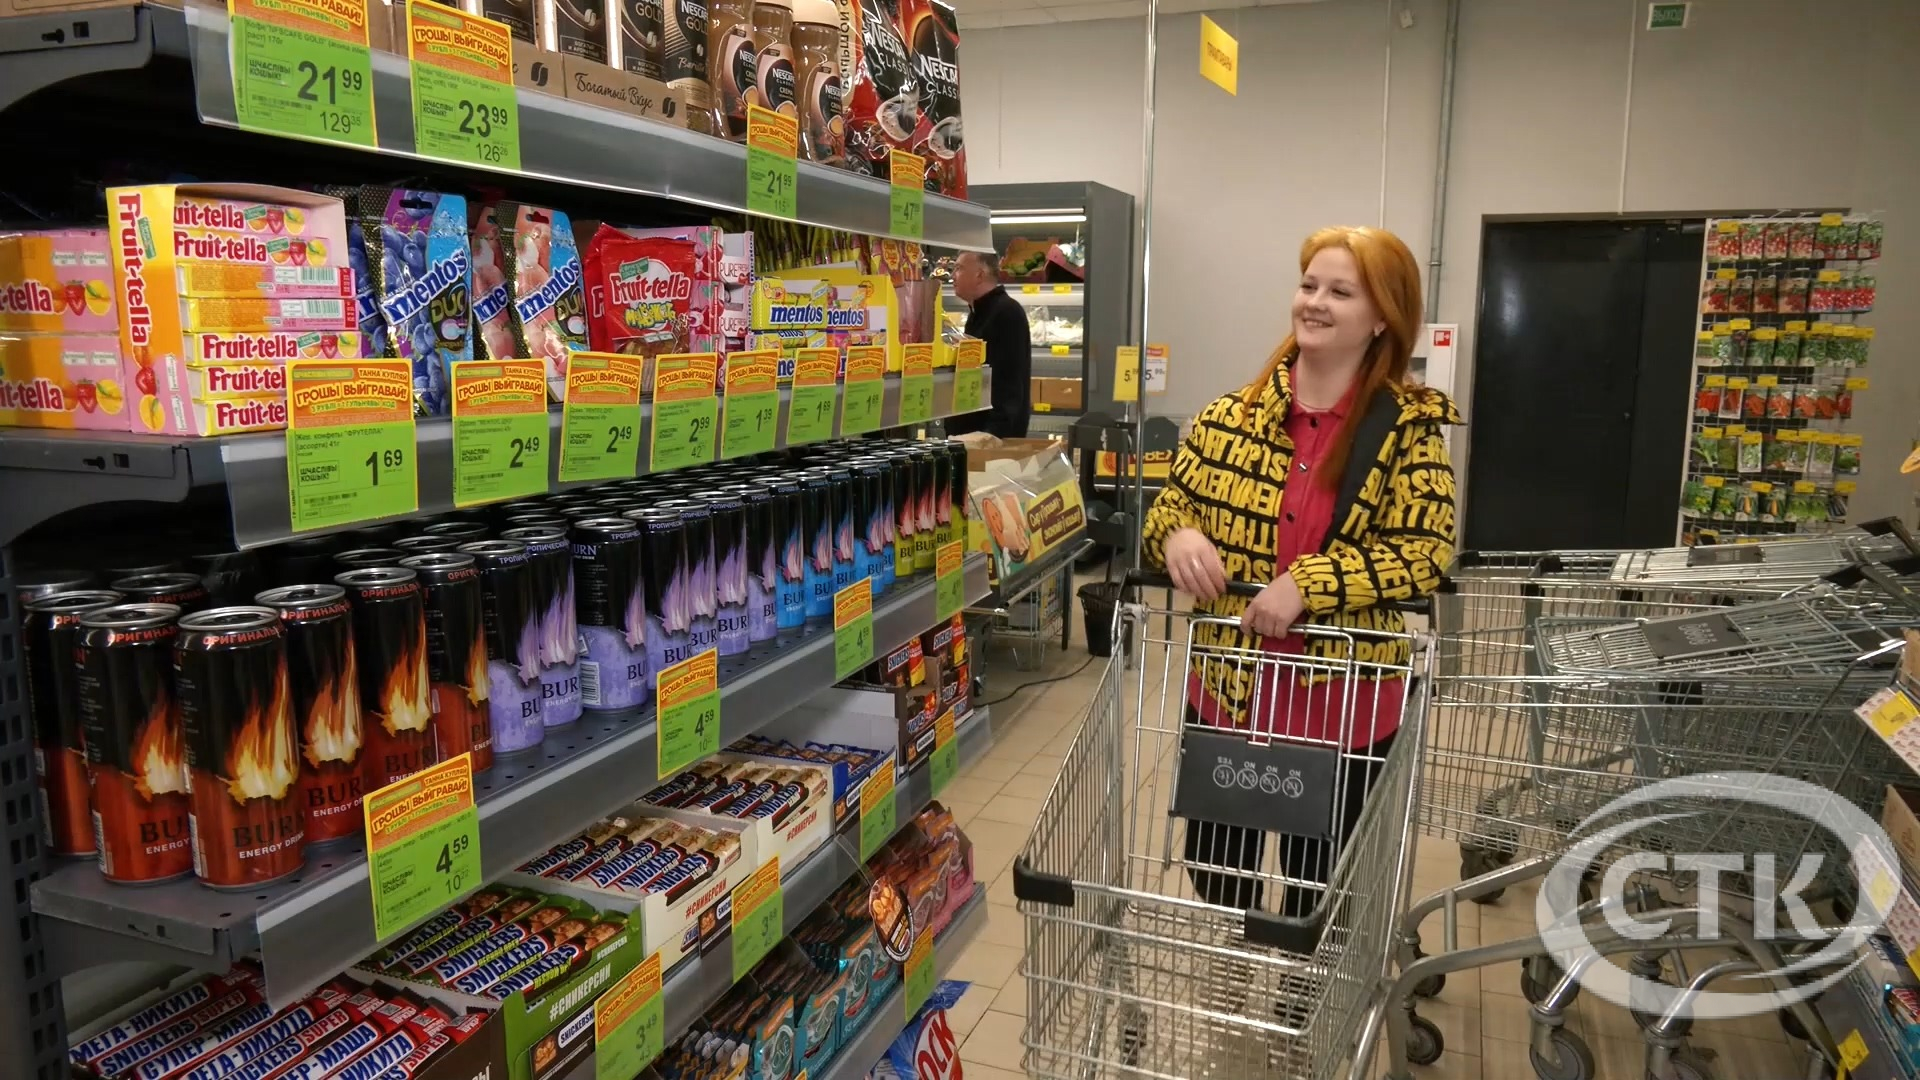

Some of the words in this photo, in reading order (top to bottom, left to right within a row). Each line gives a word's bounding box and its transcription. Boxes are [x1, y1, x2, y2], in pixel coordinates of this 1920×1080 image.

[636, 3, 663, 23] GOLD
[414, 28, 451, 42] ГРОШЫ
[454, 34, 507, 63] ВЫЙГРАВАЙ!
[249, 60, 291, 74] ШЧАСЛІВЫ
[249, 68, 281, 80] КОШЫК!
[921, 54, 958, 85] NESCA
[297, 61, 336, 104] 21
[342, 69, 362, 90] 99
[575, 72, 626, 101] Богатый
[629, 87, 654, 115] Вкус
[926, 82, 958, 99] CLASS
[320, 111, 351, 133] 129
[351, 115, 361, 127] 35
[459, 100, 491, 137] 23
[491, 106, 508, 125] 99
[476, 143, 500, 162] 126
[767, 170, 782, 195] 21
[784, 174, 792, 187] 99
[175, 232, 267, 262] Fruit-tella
[118, 194, 148, 344] Fruit-tella
[720, 262, 738, 278] PURE
[384, 250, 469, 323] mentos
[516, 257, 582, 321] mentos
[610, 274, 689, 304] Fruit-tella
[720, 316, 738, 332] PURE
[770, 304, 823, 323] mentos
[203, 335, 298, 359] Fruit-tella
[208, 368, 286, 392] Fruit-tel
[359, 369, 381, 378] ТАННА
[382, 371, 409, 380] КУПЛЯЙ
[571, 373, 598, 386] ГРОШЫ
[600, 371, 638, 388] ВЫЙГРАВАЙ!
[0, 380, 63, 410] it-tella
[296, 385, 340, 405] ГРОШЫ
[343, 381, 407, 399] ВЫЙГРАВАЙ!
[459, 382, 490, 397] ГРОШЫ
[494, 377, 541, 392] ВЫЙГРАВАЙ!
[816, 401, 822, 423] 1
[866, 395, 872, 414] 1
[689, 418, 700, 442] 2
[700, 416, 710, 429] 99
[756, 409, 763, 433] 1
[763, 408, 773, 421] 39
[606, 426, 619, 453] 2
[620, 426, 632, 440] 49
[509, 438, 524, 468] 2
[525, 436, 540, 452] 49
[300, 472, 329, 483] КОШЫК!
[301, 464, 337, 475] ШЧАСЛІВЫ
[365, 451, 378, 486] 1
[384, 449, 403, 467] 69
[763, 602, 777, 617] BU
[107, 626, 177, 643] ОРИГИНАЛ
[718, 615, 748, 632] BUR
[857, 630, 863, 648] 4
[664, 646, 691, 664] BUR
[889, 646, 909, 670] SNICKERS
[626, 664, 646, 680] BU
[541, 676, 579, 700] BUR
[521, 698, 541, 719] BU
[695, 712, 704, 737] 4
[704, 708, 714, 723] 59
[1243, 760, 1256, 769] NO
[308, 777, 361, 807] BUR
[424, 775, 444, 785] ТАННА
[313, 802, 353, 817] ENERGY
[373, 803, 410, 832] ГРОШЫ
[412, 779, 468, 808] ВЫЙГРАВАЙ!
[139, 815, 183, 846] BU
[146, 837, 190, 854] ENERGY
[239, 843, 282, 860] ENERGY
[436, 843, 453, 875] 4
[453, 834, 469, 855] 59
[594, 841, 654, 884] SNICKERS
[619, 848, 680, 887] SNICKERS
[382, 869, 414, 888] ШЧАСЛІВЫ
[383, 878, 408, 895] КОШЫК!
[446, 874, 461, 895] 10
[762, 916, 769, 937] 3
[441, 924, 525, 980] SNICKERS
[456, 935, 548, 994] SNICKERS
[492, 944, 580, 1000] SNICKERS
[550, 963, 611, 1022] #СНИКЕРСНИ
[70, 985, 208, 1062] МЕГА-НИКИТА
[101, 1017, 196, 1076] SNICKERS
[200, 990, 245, 1023] SUPER
[303, 1011, 350, 1044] SUPER
[635, 1025, 646, 1050] 3
[646, 1013, 657, 1029] 49
[140, 1002, 273, 1080] СУПЕР-МАША
[282, 1024, 377, 1080] ЕР-МАША
[407, 1034, 449, 1070] SUPER
